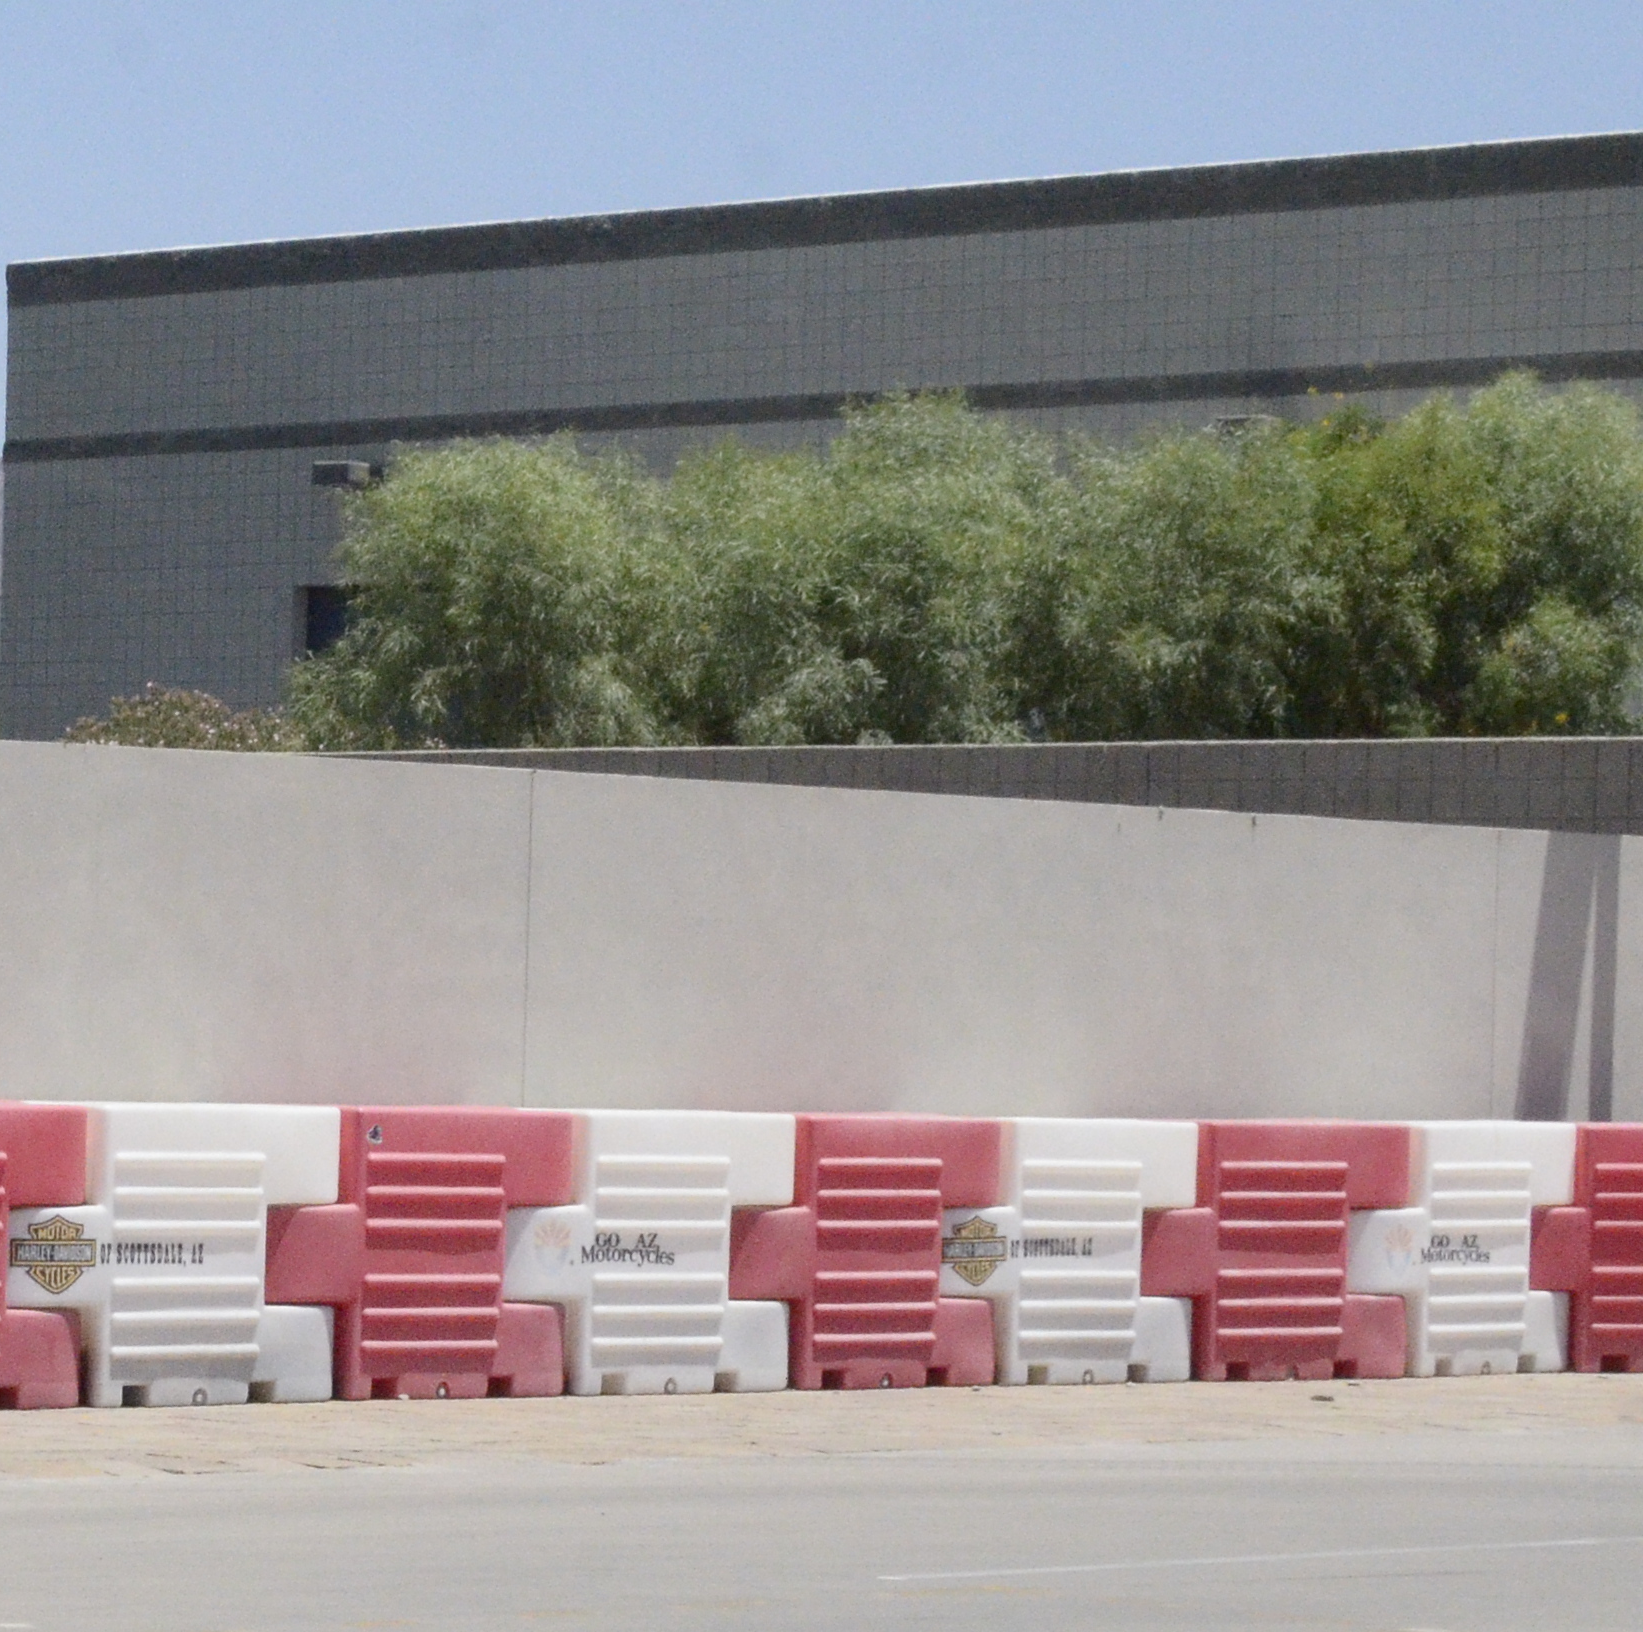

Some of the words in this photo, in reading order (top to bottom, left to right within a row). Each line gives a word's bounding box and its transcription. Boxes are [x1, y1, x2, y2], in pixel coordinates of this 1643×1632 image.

[37, 1224, 77, 1240] MOTOR
[595, 1232, 620, 1248] GO
[635, 1232, 658, 1249] AZ
[1430, 1234, 1450, 1249] GO
[100, 1243, 112, 1264] OF
[581, 1245, 675, 1267] Motorcycles
[35, 1266, 76, 1288] CYCLES
